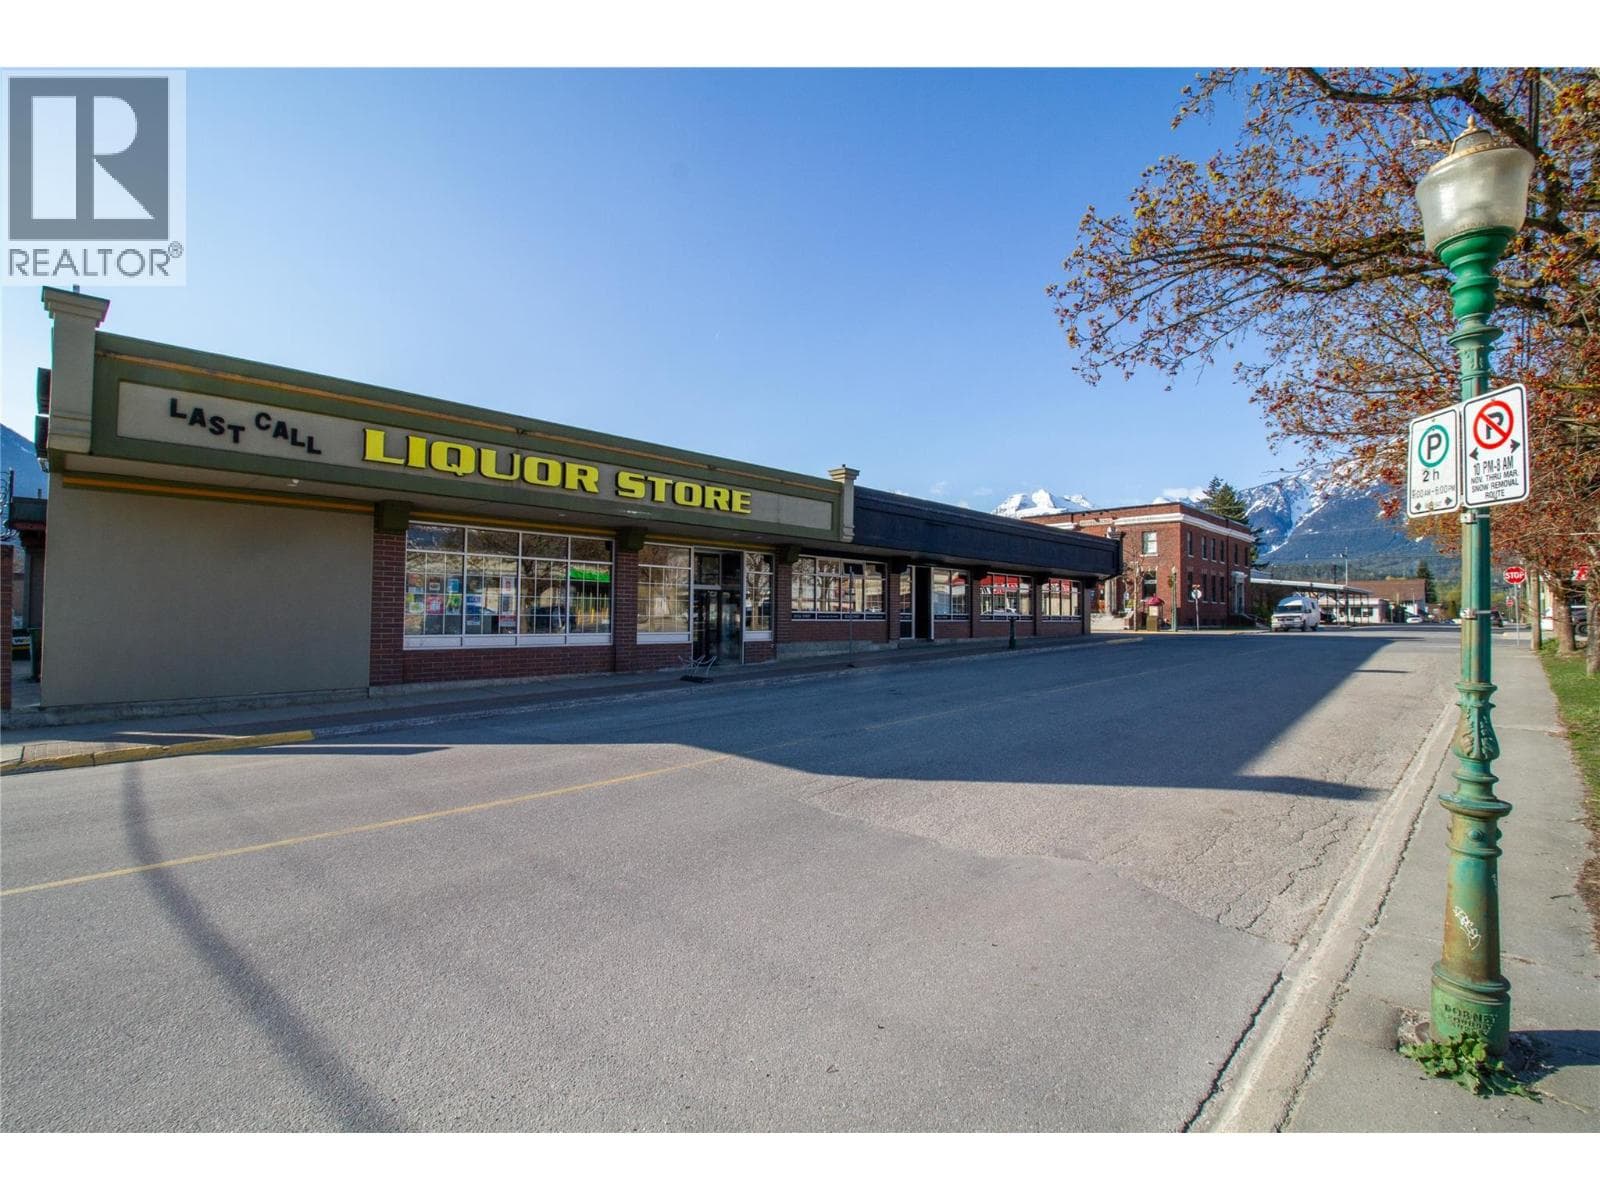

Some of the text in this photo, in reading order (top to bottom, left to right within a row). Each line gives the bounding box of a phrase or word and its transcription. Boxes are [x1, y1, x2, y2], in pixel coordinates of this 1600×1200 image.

[169, 397, 322, 455] LAST CALL
[363, 428, 753, 514] LIQUOR STORE
[1473, 462, 1481, 476] 10
[1502, 455, 1514, 471] AM
[1422, 470, 1430, 483] 2
[1485, 473, 1502, 482] THRU
[1471, 477, 1520, 493] SNOW REMOVAL
[1485, 489, 1505, 498] ROUTE
[1505, 571, 1525, 579] STOP
